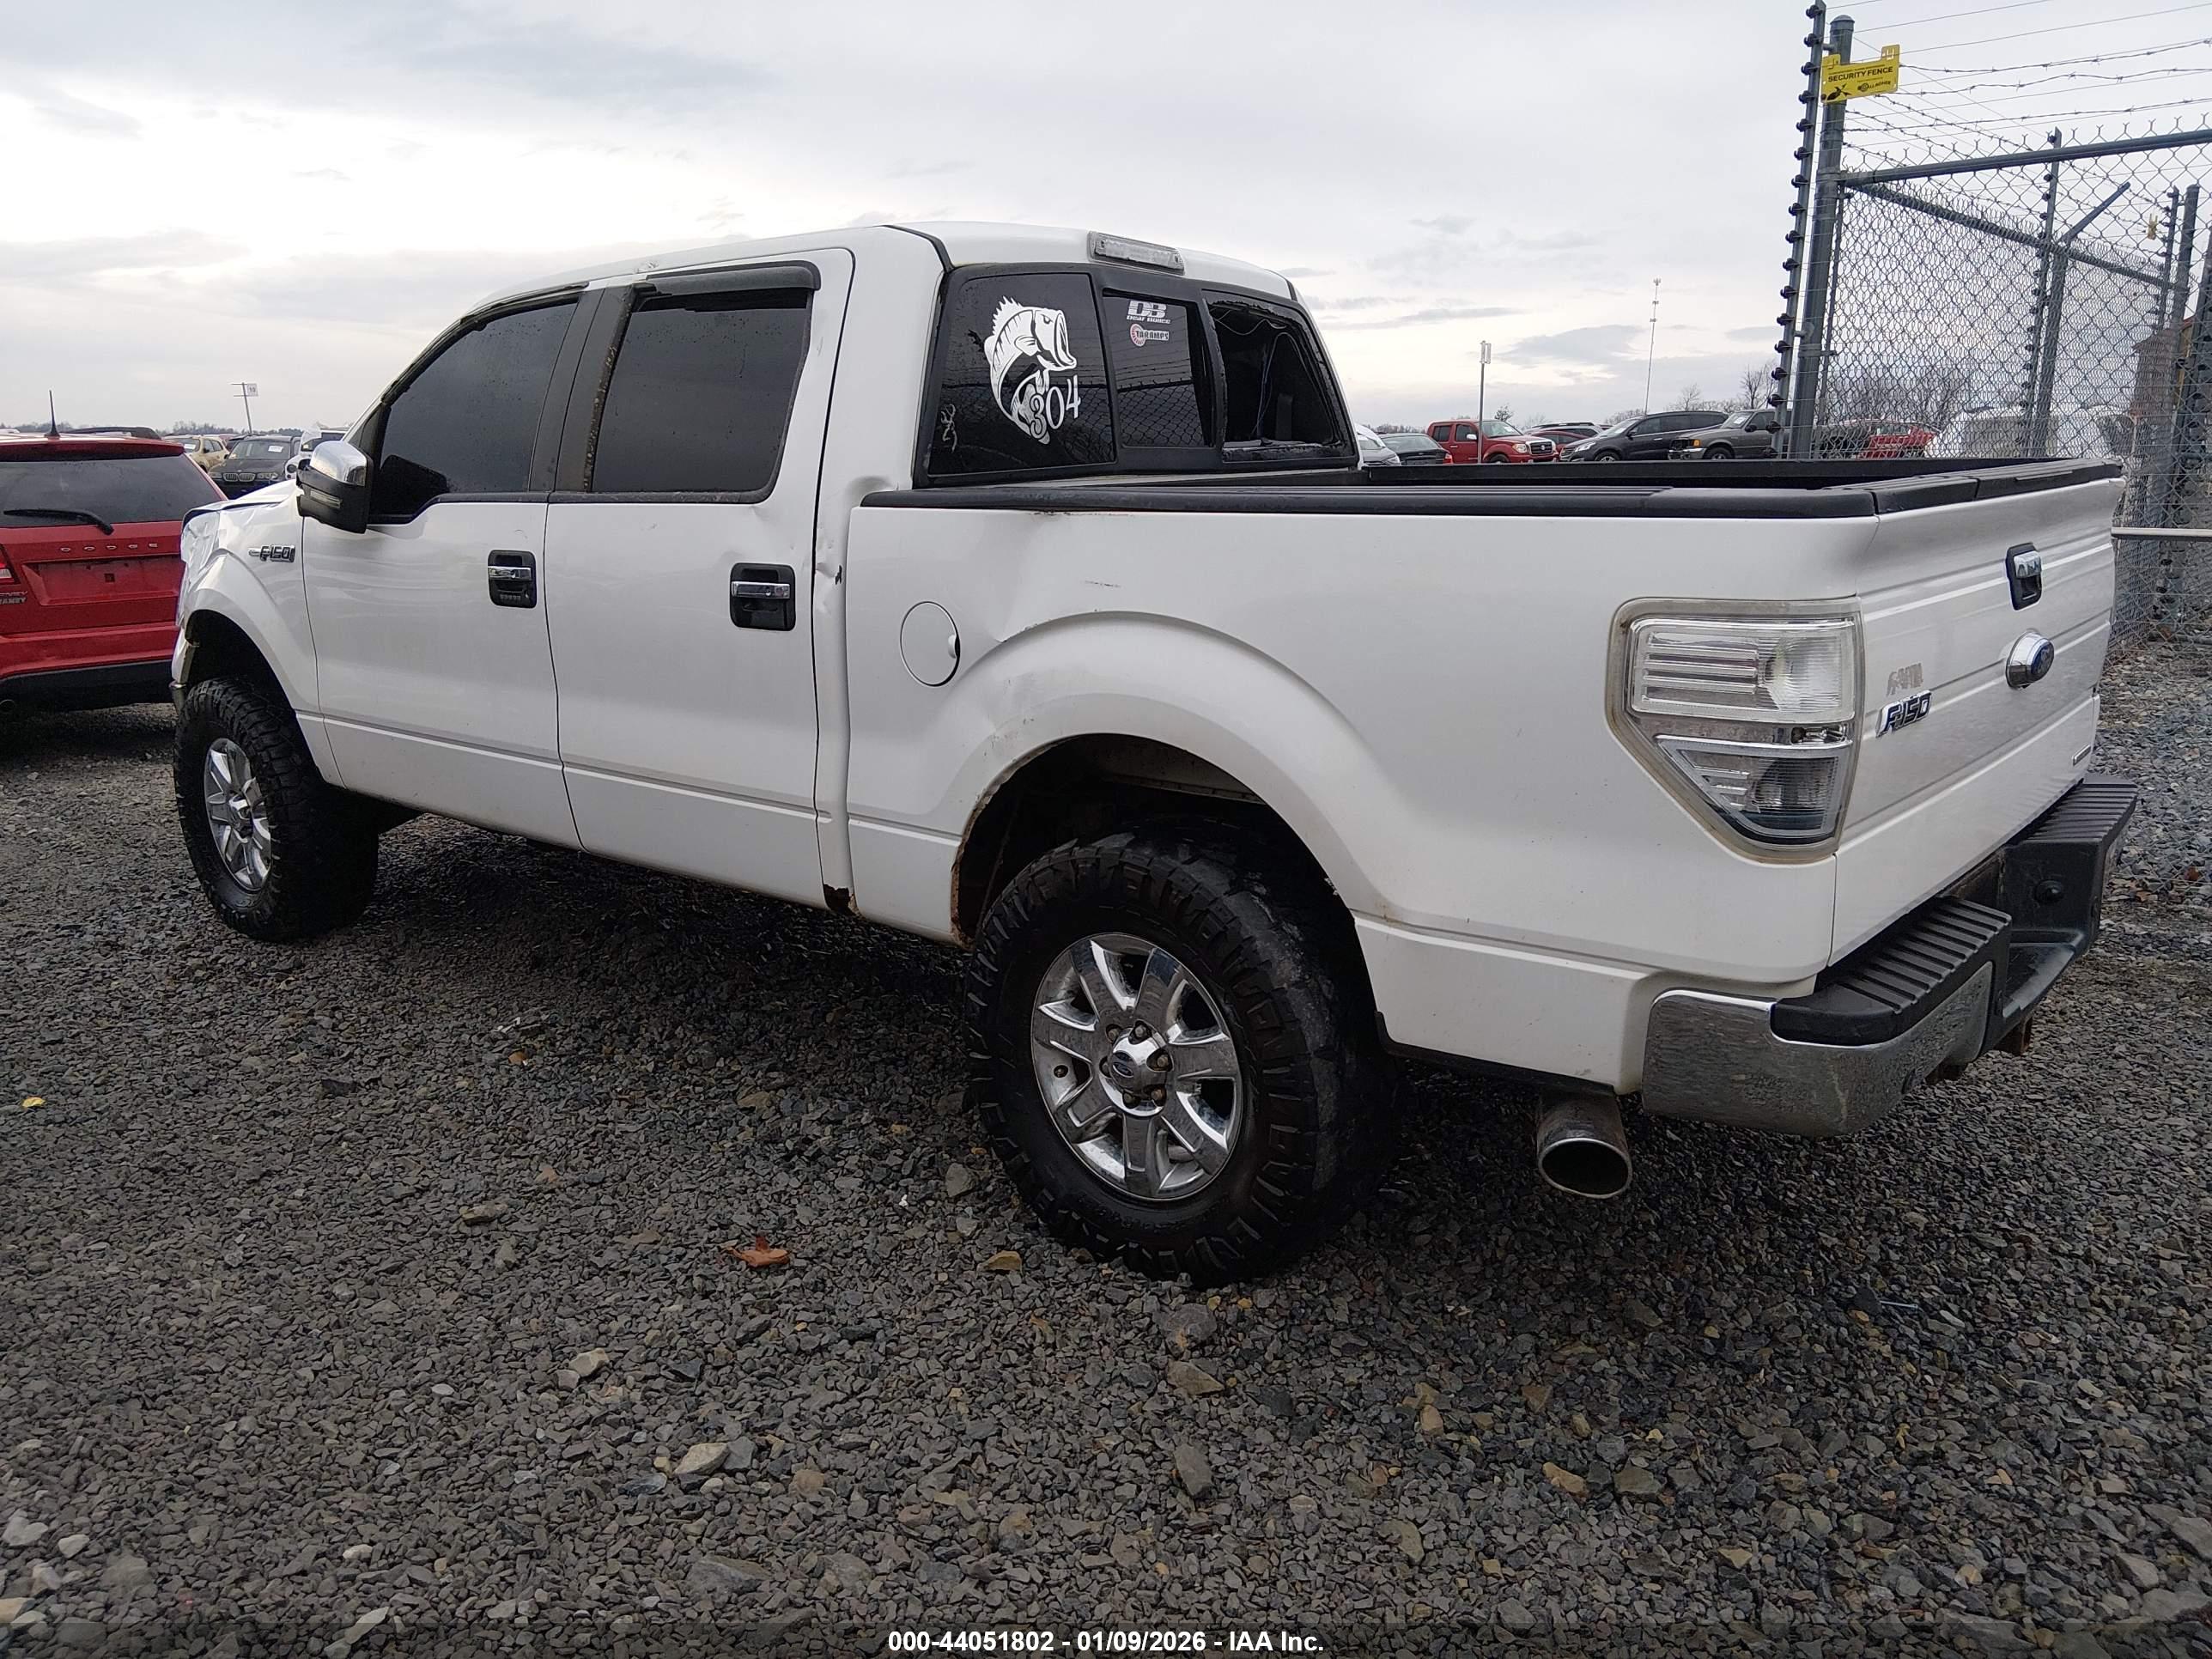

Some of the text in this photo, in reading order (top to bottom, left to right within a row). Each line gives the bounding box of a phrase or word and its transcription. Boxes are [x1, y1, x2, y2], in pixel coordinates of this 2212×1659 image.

[1828, 70, 1867, 82] SECURITY
[1867, 66, 1894, 76] FENCE
[1127, 300, 1168, 319] DB
[1135, 330, 1169, 340] TARAMPS
[1029, 374, 1082, 439] 304
[59, 542, 158, 554] DODGE
